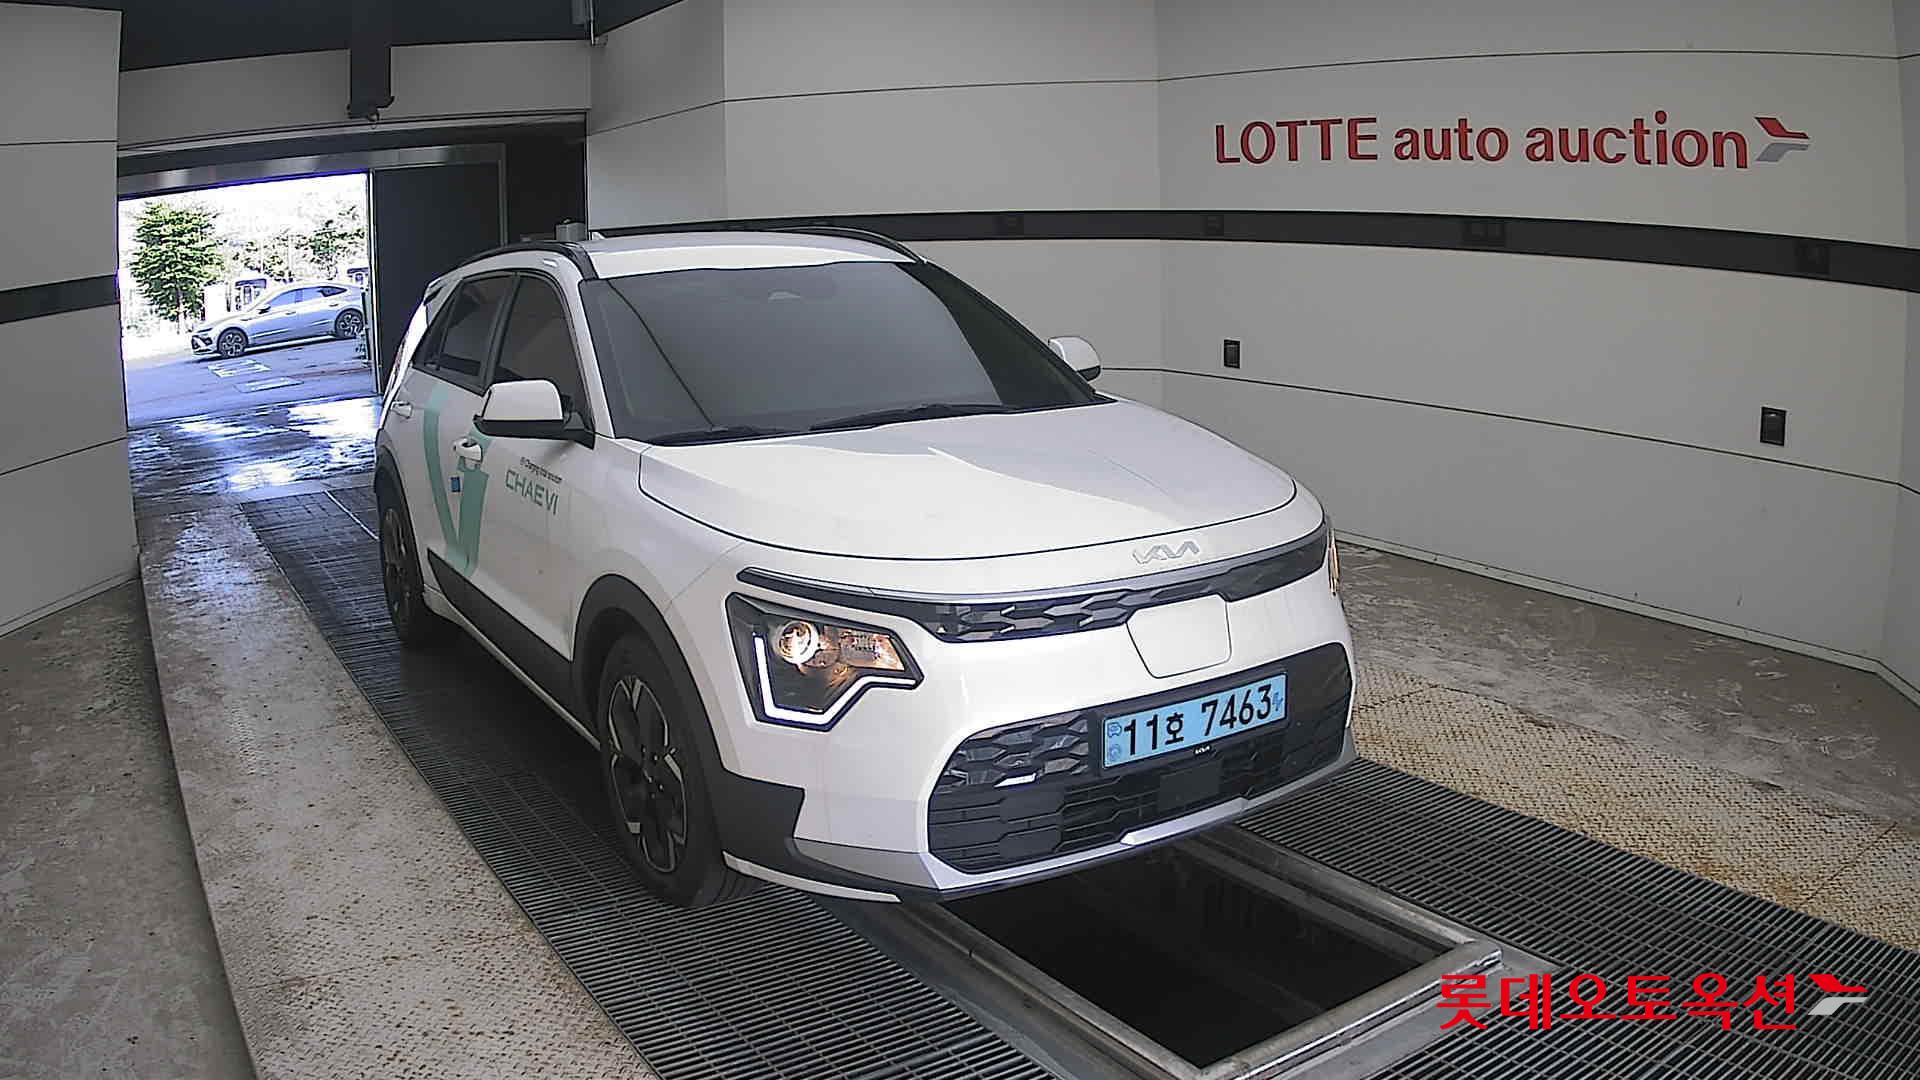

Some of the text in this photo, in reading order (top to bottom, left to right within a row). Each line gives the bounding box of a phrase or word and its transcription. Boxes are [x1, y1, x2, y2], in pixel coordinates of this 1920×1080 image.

[1215, 111, 1749, 168] LOTTE auto auction
[505, 469, 559, 516] CHAEVI
[1123, 683, 1272, 756] 11호 7463
